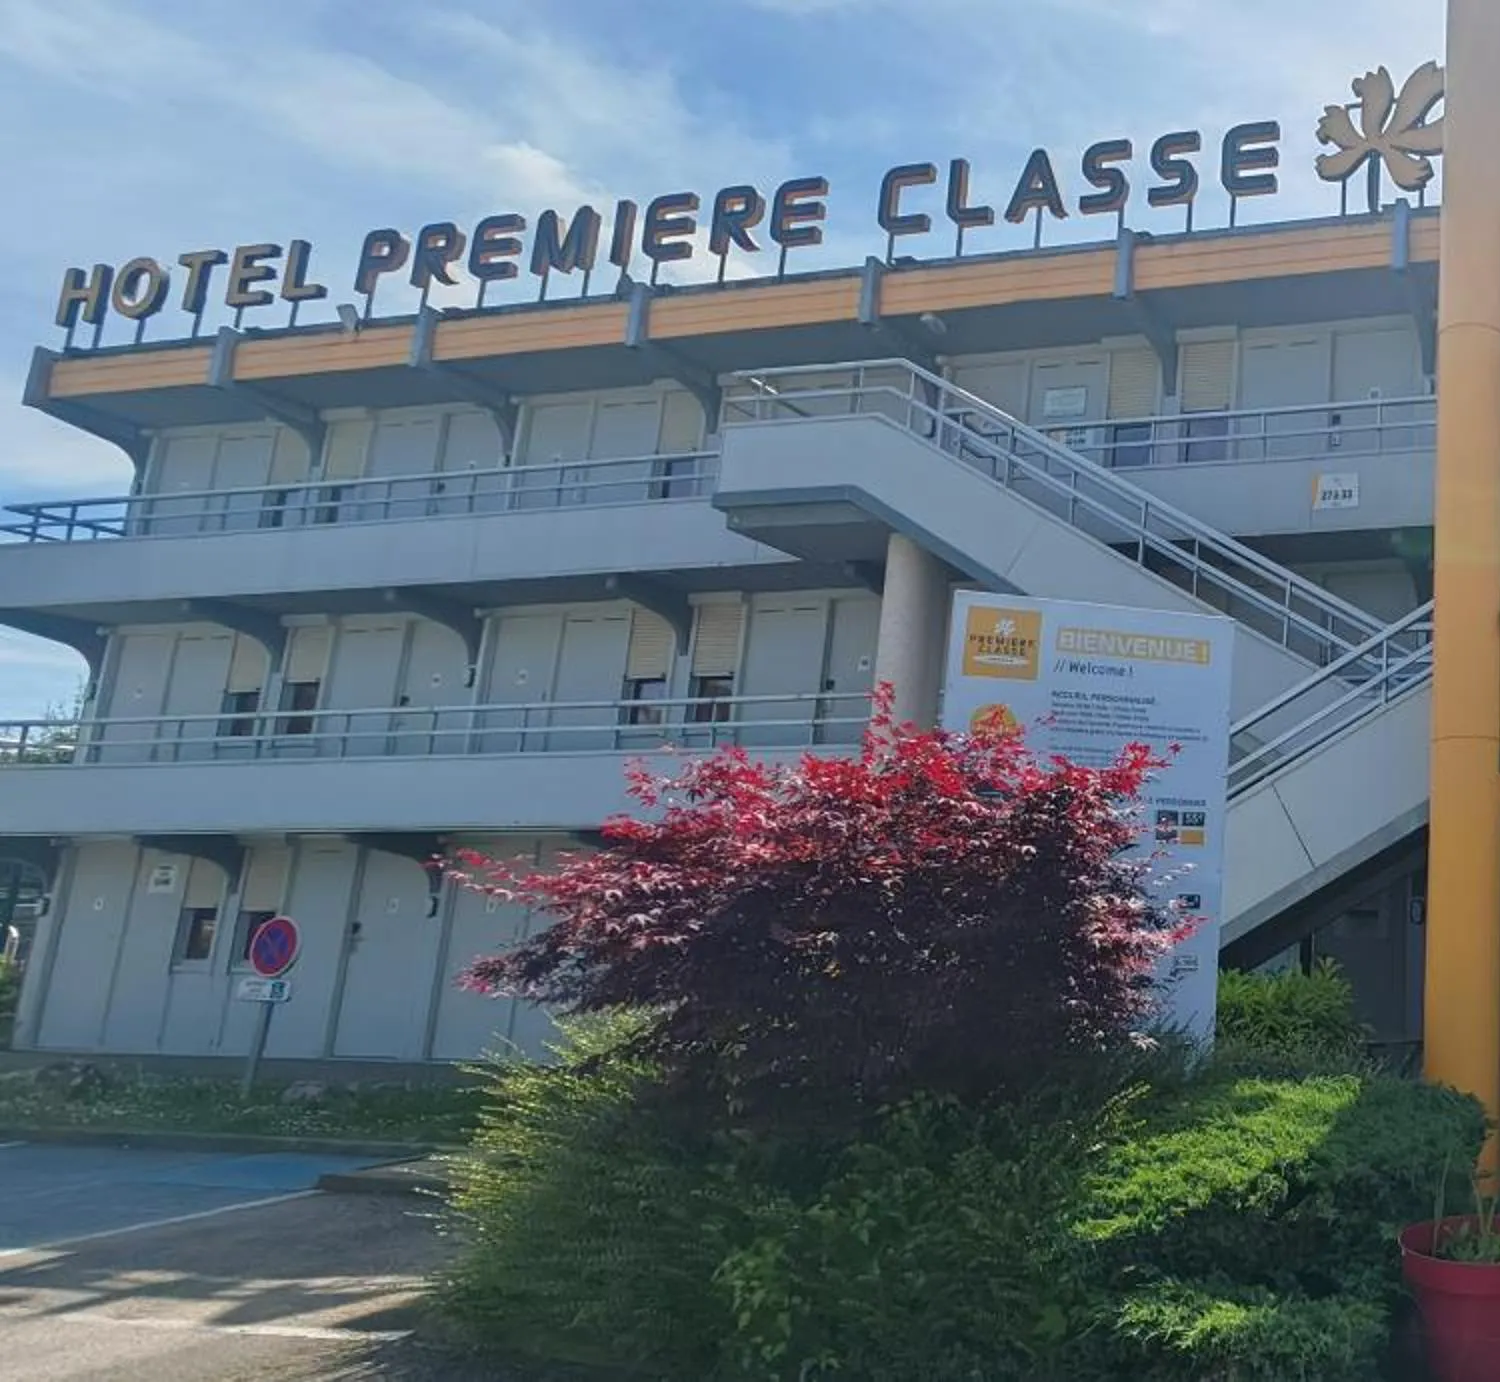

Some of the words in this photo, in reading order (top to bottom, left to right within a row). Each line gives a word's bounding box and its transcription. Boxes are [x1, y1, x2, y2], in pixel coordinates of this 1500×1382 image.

[55, 240, 327, 327] HOTEL
[354, 177, 829, 294] PREMIERE
[877, 120, 1281, 236] CLASSE
[1060, 631, 1196, 660] BIENVENUE
[1069, 660, 1127, 677] Welcome
